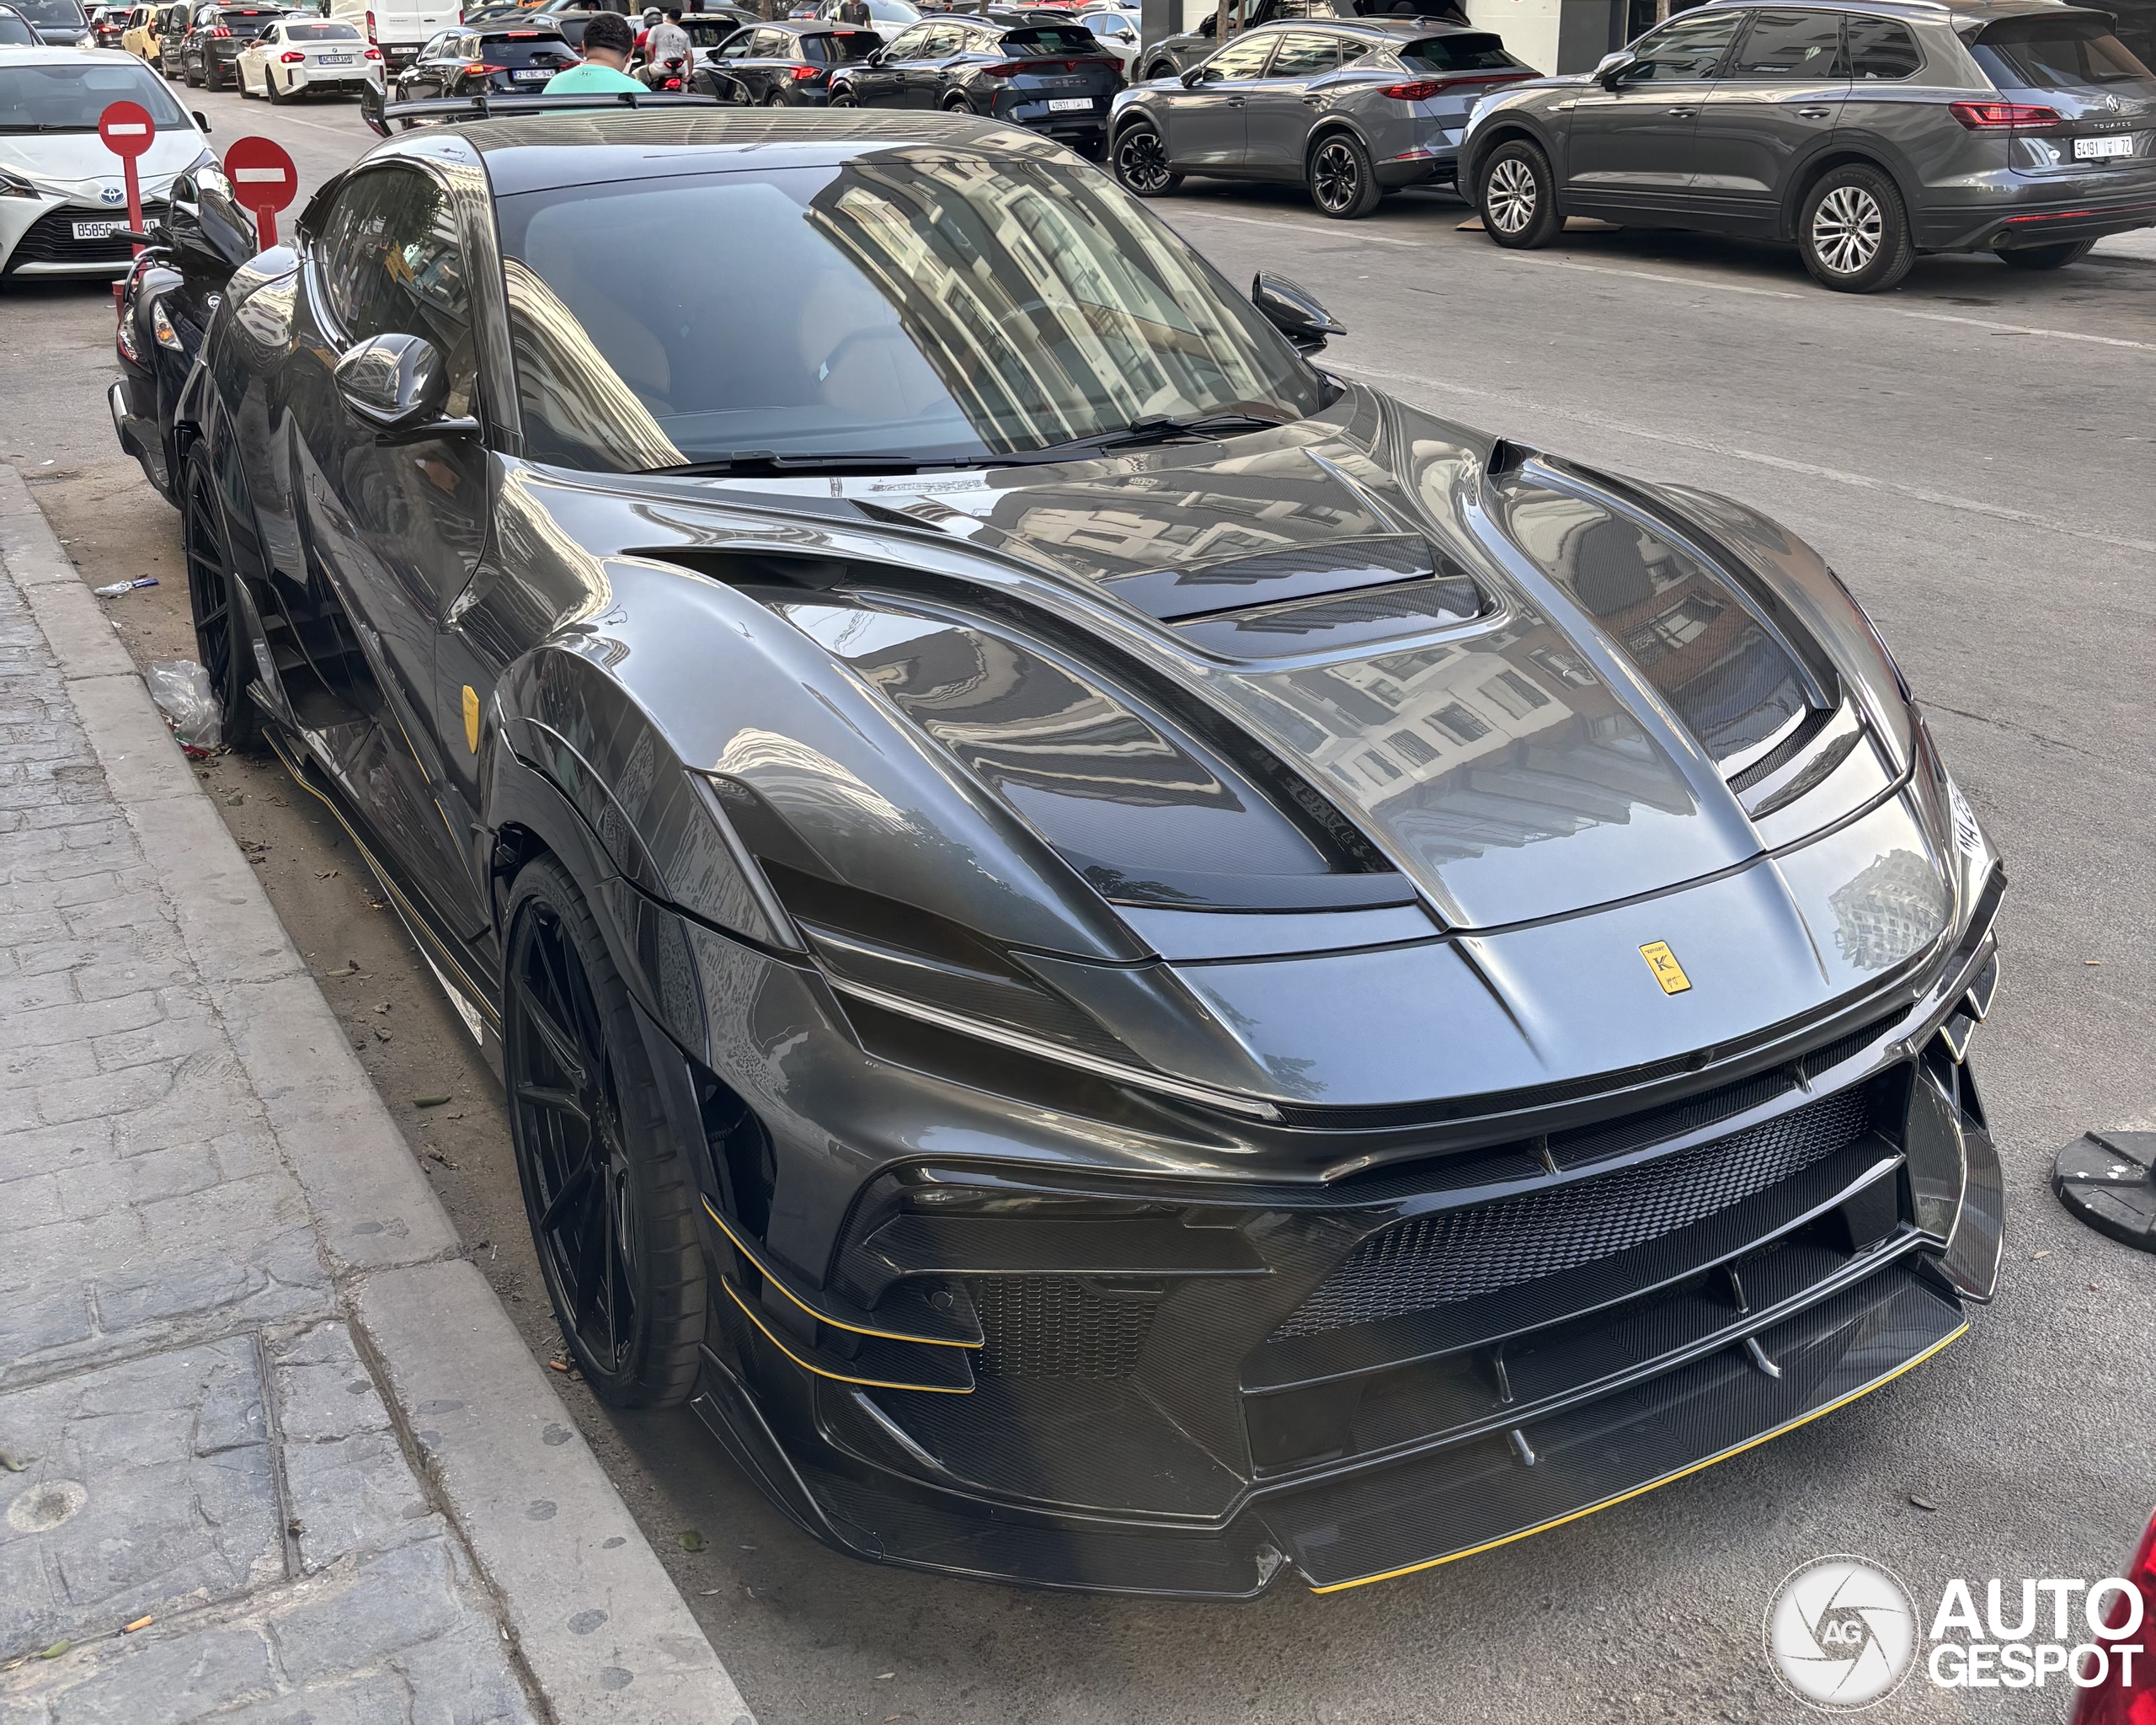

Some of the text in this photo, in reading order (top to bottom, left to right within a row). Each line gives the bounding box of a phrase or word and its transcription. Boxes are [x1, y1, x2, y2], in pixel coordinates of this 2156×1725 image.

[2077, 142, 2099, 156] 54191
[2121, 139, 2131, 152] 72
[77, 222, 112, 237] 85856
[1652, 954, 1674, 971] K
